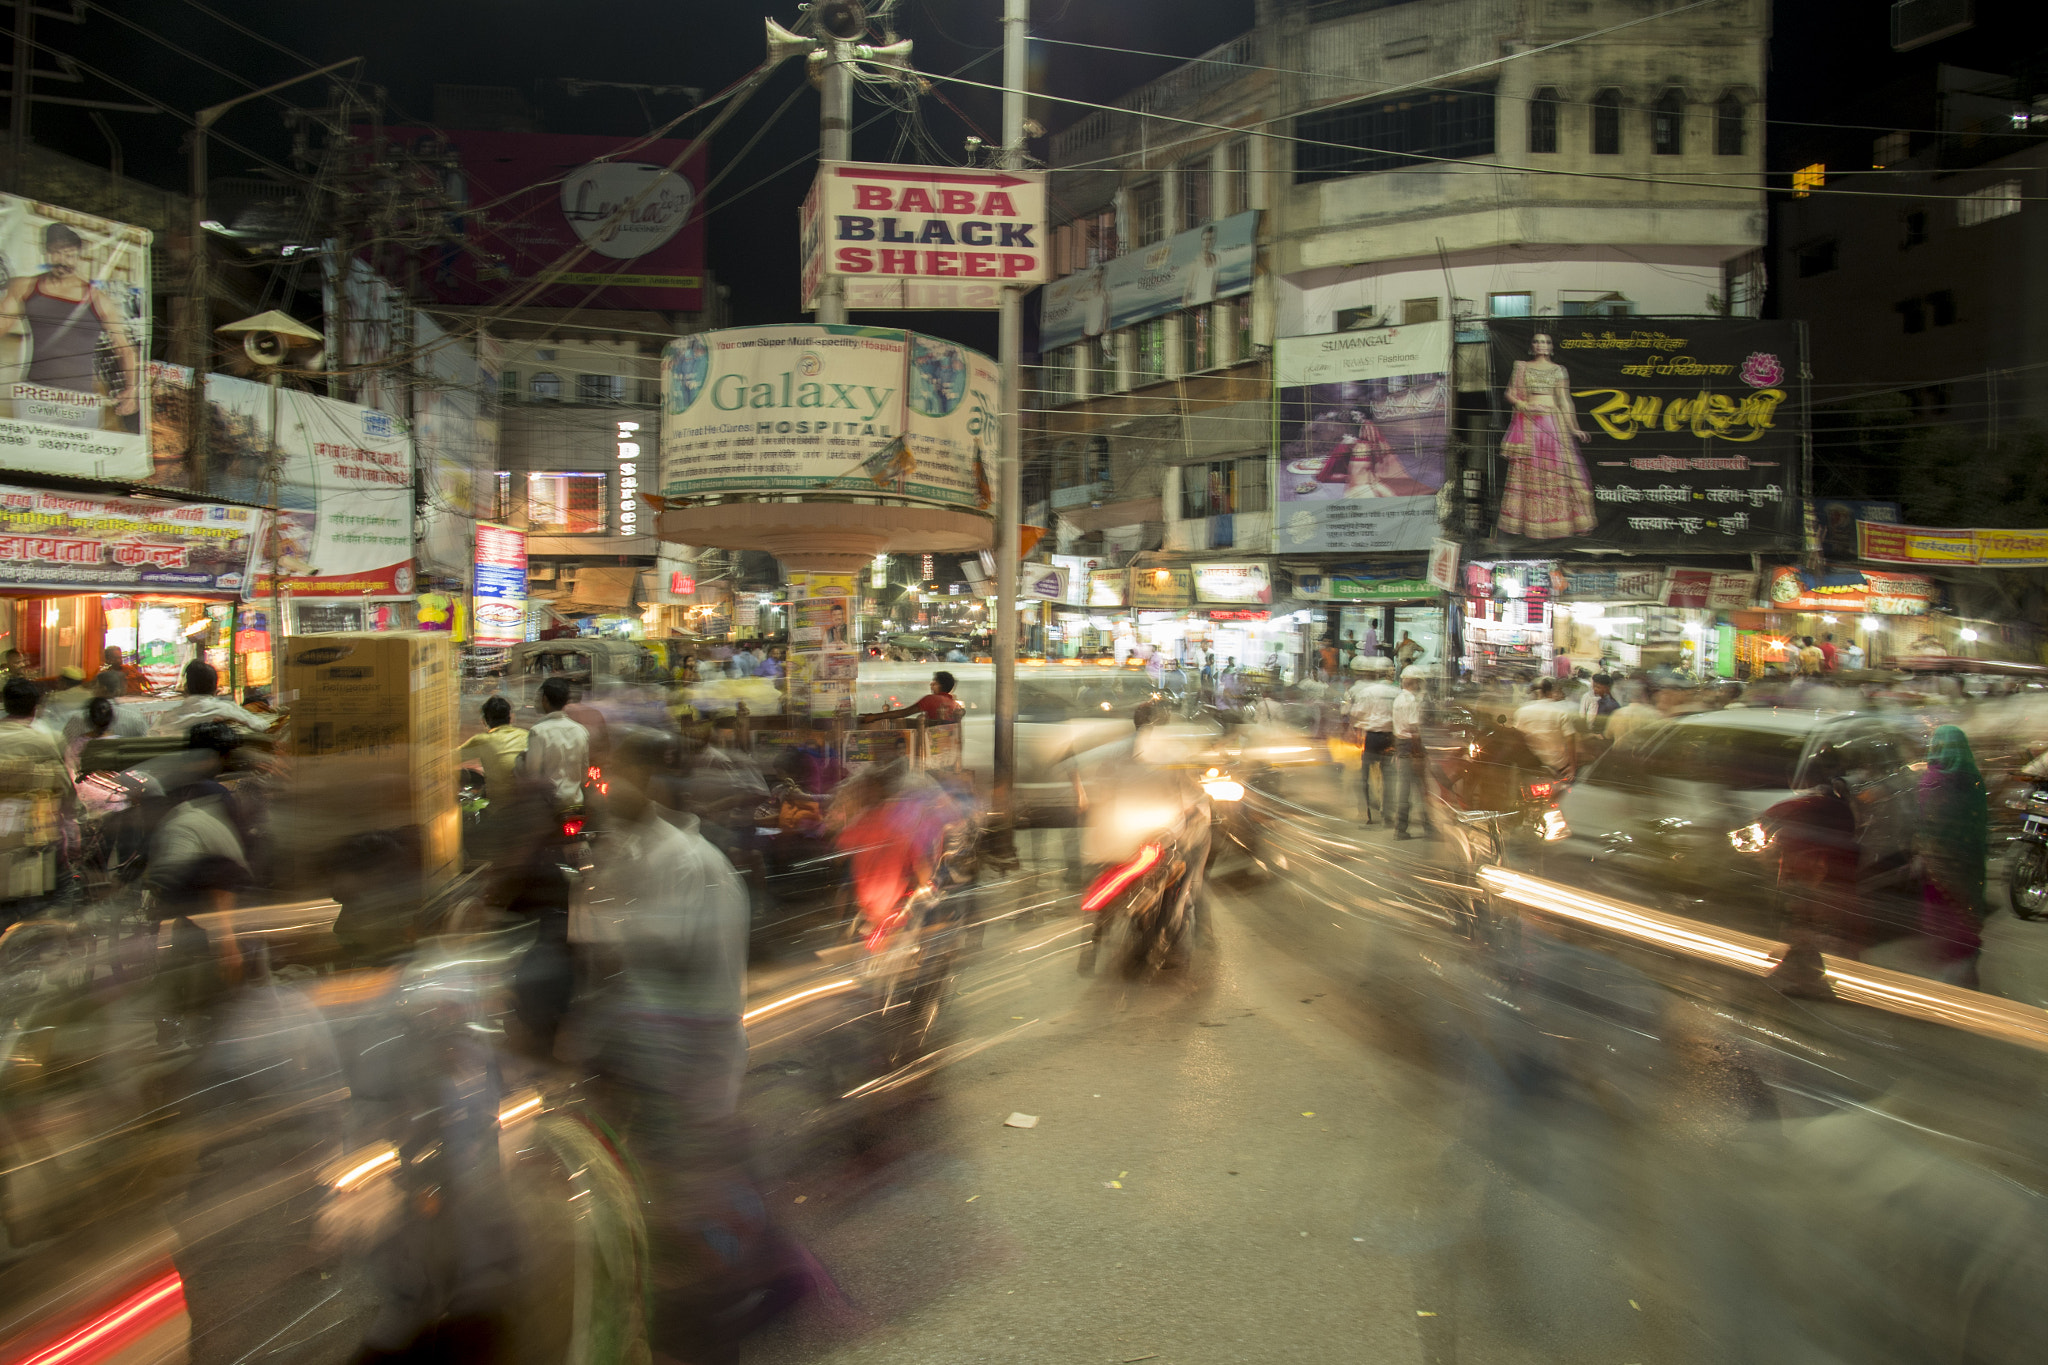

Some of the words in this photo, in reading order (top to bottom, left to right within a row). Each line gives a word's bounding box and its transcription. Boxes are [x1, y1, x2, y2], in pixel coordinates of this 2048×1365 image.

[852, 185, 1021, 217] BABA
[834, 215, 1039, 248] BLACK
[834, 247, 1040, 278] SHEEP
[757, 338, 787, 348] Super
[861, 341, 904, 353] Hospital
[12, 385, 103, 408] PREMIUM
[711, 371, 897, 421] Galaxy
[756, 421, 893, 438] HOSPITAL
[1378, 583, 1415, 594] Bank
